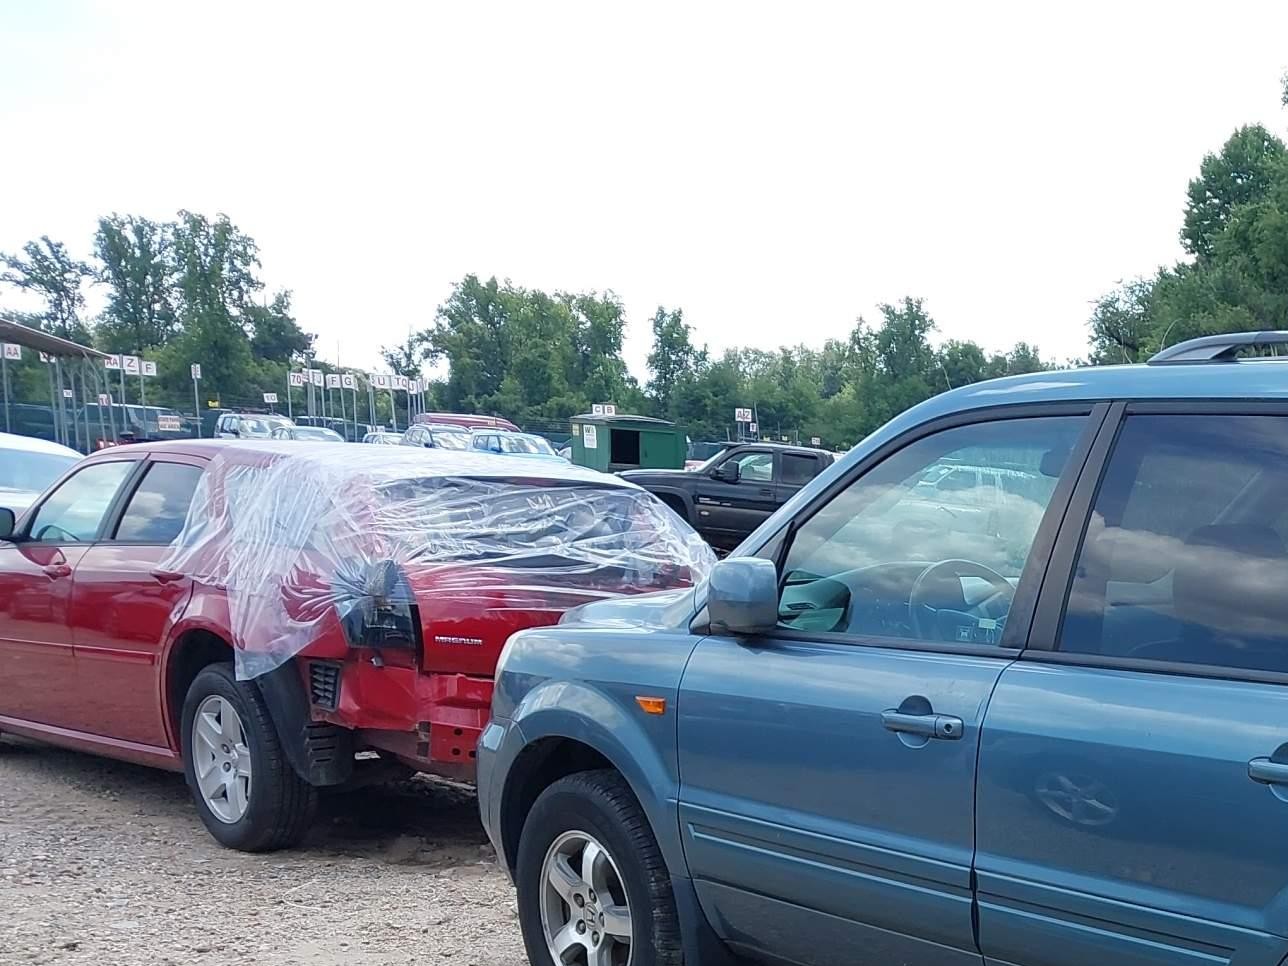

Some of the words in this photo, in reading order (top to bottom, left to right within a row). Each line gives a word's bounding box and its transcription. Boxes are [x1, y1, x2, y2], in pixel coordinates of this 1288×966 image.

[6, 346, 19, 358] AA
[145, 363, 153, 373] F
[344, 376, 352, 386] G
[377, 376, 386, 386] U
[435, 635, 482, 646] MAGNUM
